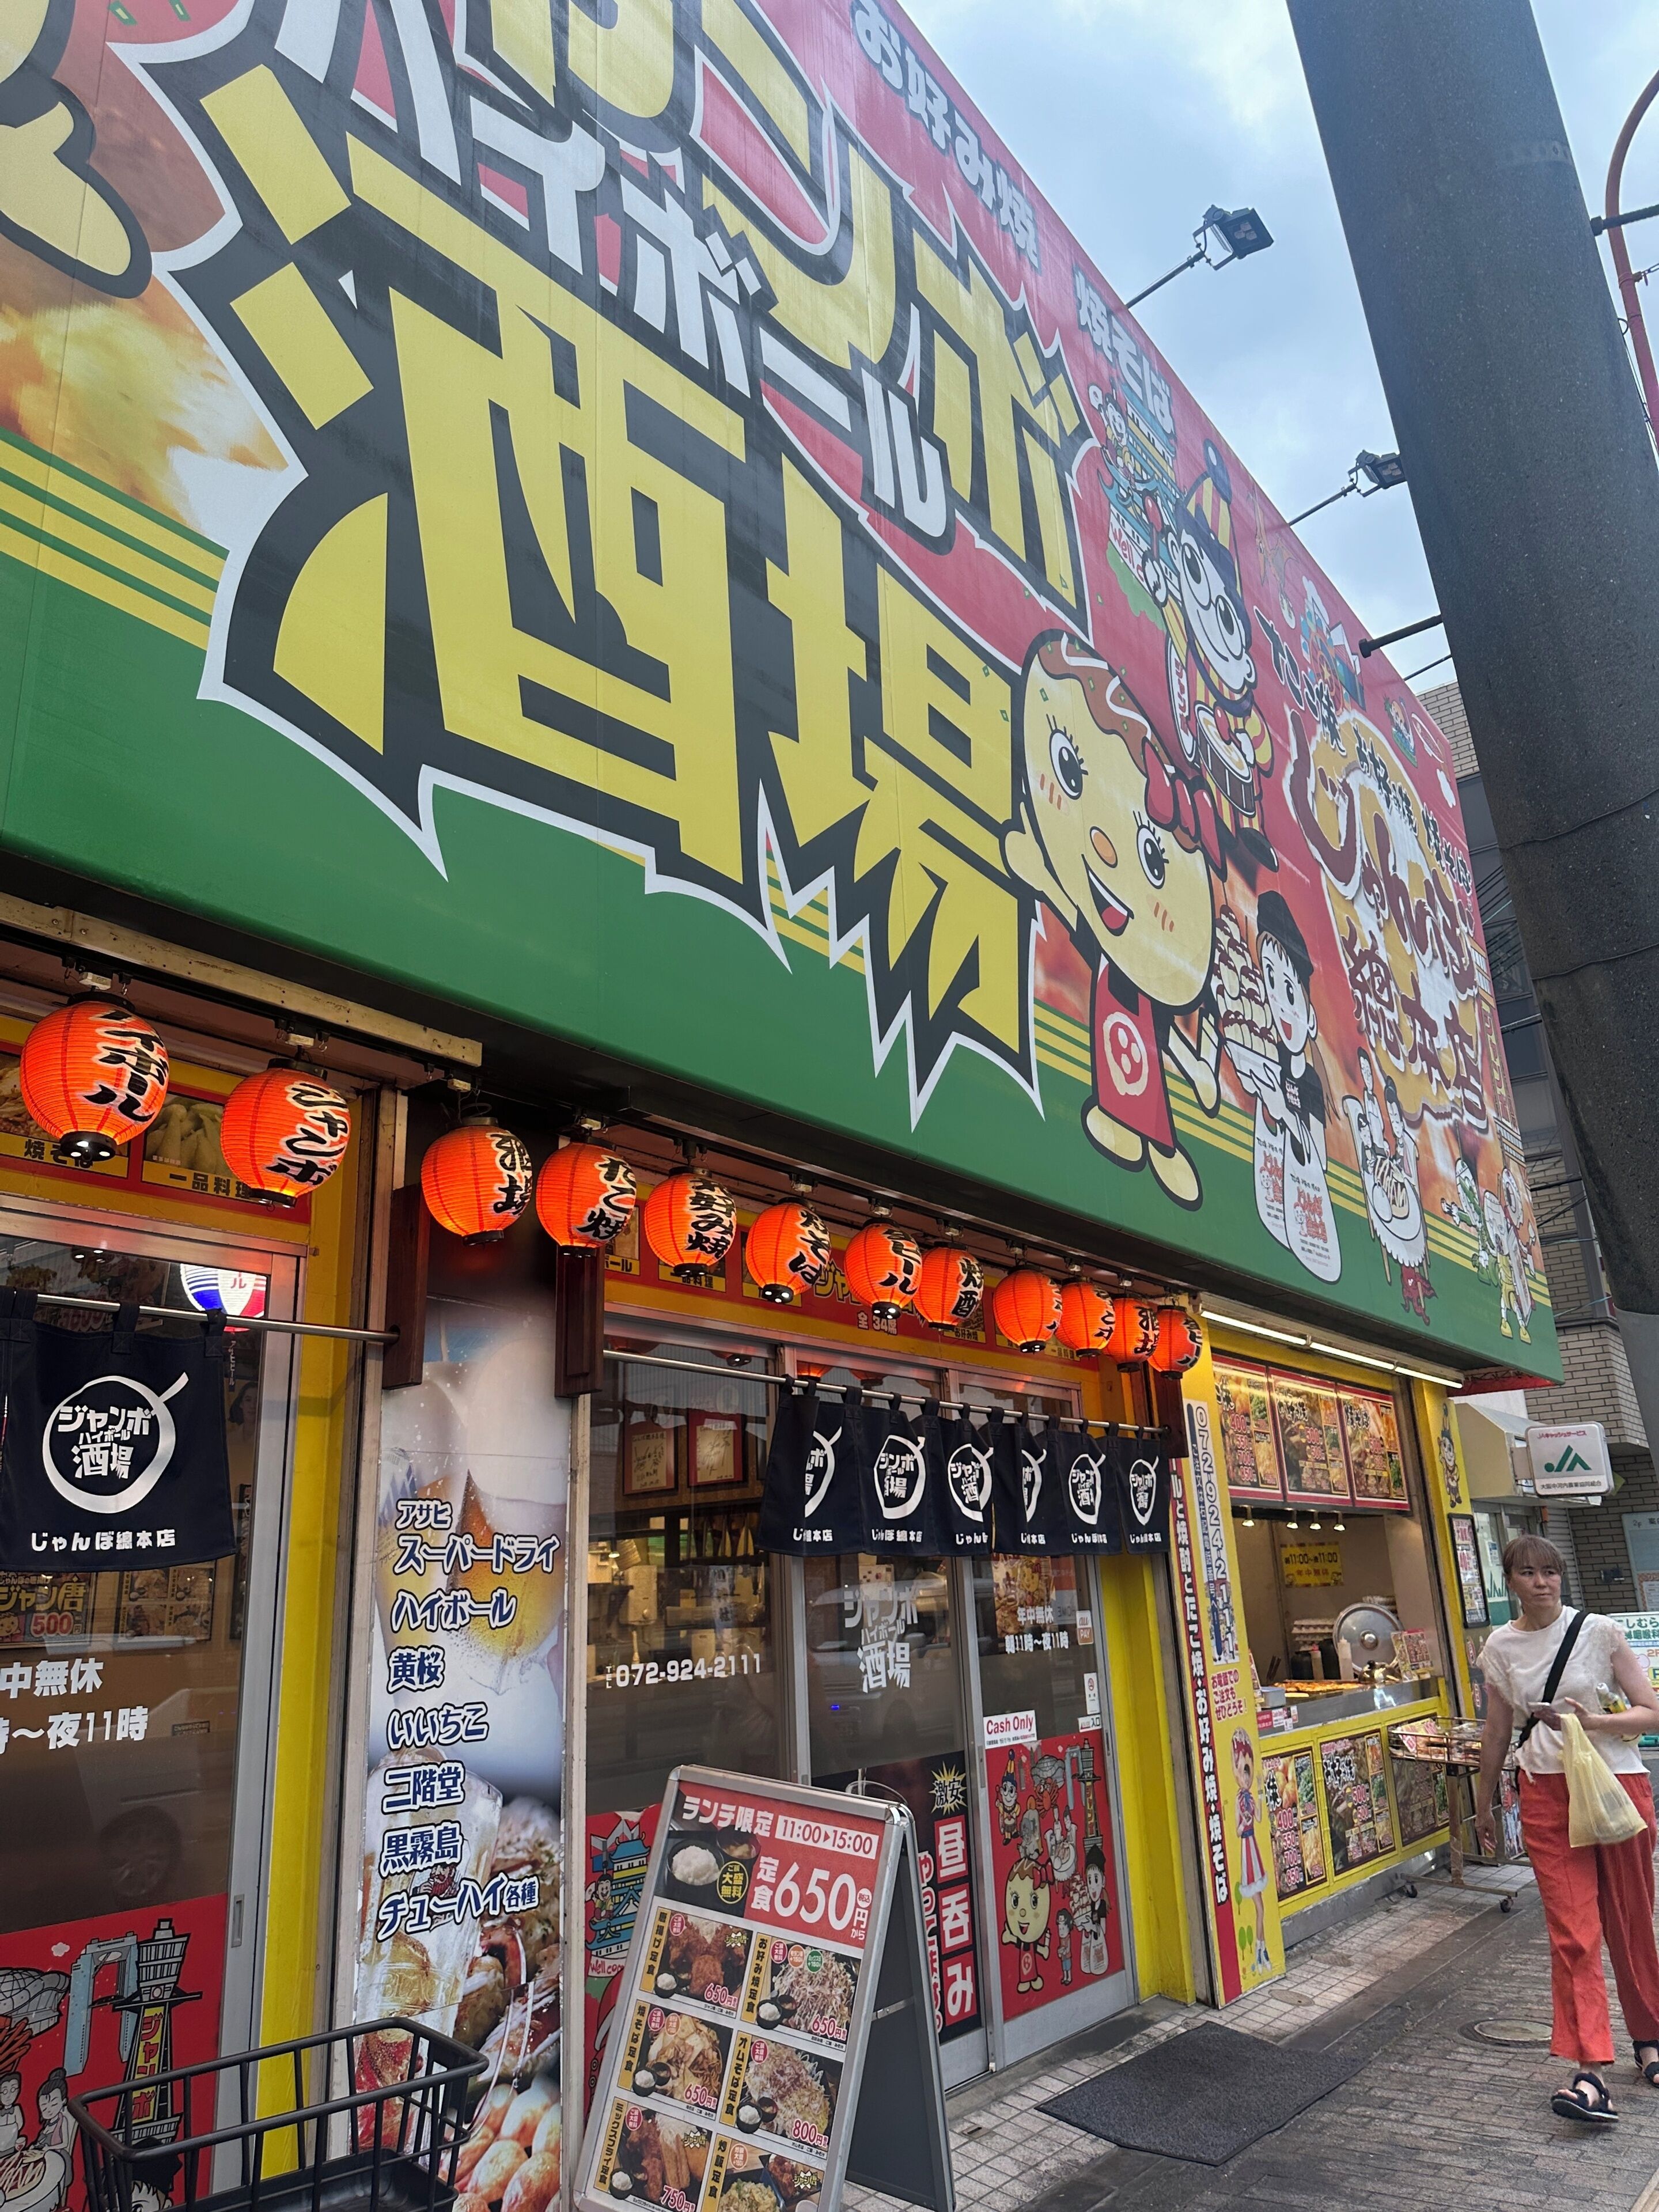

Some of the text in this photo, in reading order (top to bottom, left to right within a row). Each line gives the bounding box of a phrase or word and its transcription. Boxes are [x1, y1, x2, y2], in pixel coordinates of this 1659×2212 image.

[854, 6, 1039, 271] お好み焼
[1075, 268, 1176, 434] 焼そば
[199, 63, 1023, 1040] 酒場
[169, 1172, 251, 1200] 一品料理
[577, 1156, 637, 1240] たこ焼
[58, 1406, 155, 1436] ジャンボ
[78, 1428, 130, 1444] ハイボール
[71, 1444, 134, 1479] 酒場
[396, 1499, 452, 1530] アサヒ
[1196, 1406, 1235, 1660] 072-924-2111
[1633, 1520, 1642, 1528] 2F
[393, 1533, 560, 1574] スーパードライ
[391, 1589, 516, 1633] ハイボール
[843, 1585, 919, 1629] ジャンボ
[1017, 1605, 1054, 1626] 年中無休
[1078, 1616, 1090, 1626] au
[860, 1619, 906, 1643] ハイボール
[1080, 1628, 1090, 1639] PAY
[388, 1647, 445, 1692] 黄桜
[616, 1652, 762, 1688] 072-924-2111
[857, 1639, 911, 1693] 酒場
[1211, 1669, 1239, 1690] お電話での
[1213, 1687, 1236, 1705] ご注文も
[387, 1702, 488, 1749] いいちこ
[987, 1714, 1034, 1735] Cash Only
[1091, 1717, 1100, 1727] 入口
[382, 1761, 465, 1812] 二階堂
[935, 1778, 963, 1808] 激安
[682, 1796, 873, 1855] ランチ限定 11:00 15:00
[380, 1821, 462, 1877] 黒霧島
[721, 1884, 742, 1899] 無料
[722, 1872, 744, 1885] 大盛
[751, 1855, 779, 1913] 定食
[774, 1861, 857, 1931] 650
[853, 1907, 869, 1929] 円
[850, 1927, 866, 1941] から
[938, 1822, 974, 2017] 昼呑み
[747, 1938, 768, 2014] お好み焼定食
[624, 2005, 647, 2073] 焼そば定食
[725, 2036, 748, 2116] オムそば定食
[599, 2102, 624, 2185] ミックスフライ定食
[708, 2139, 728, 2199] 炒飯定食
